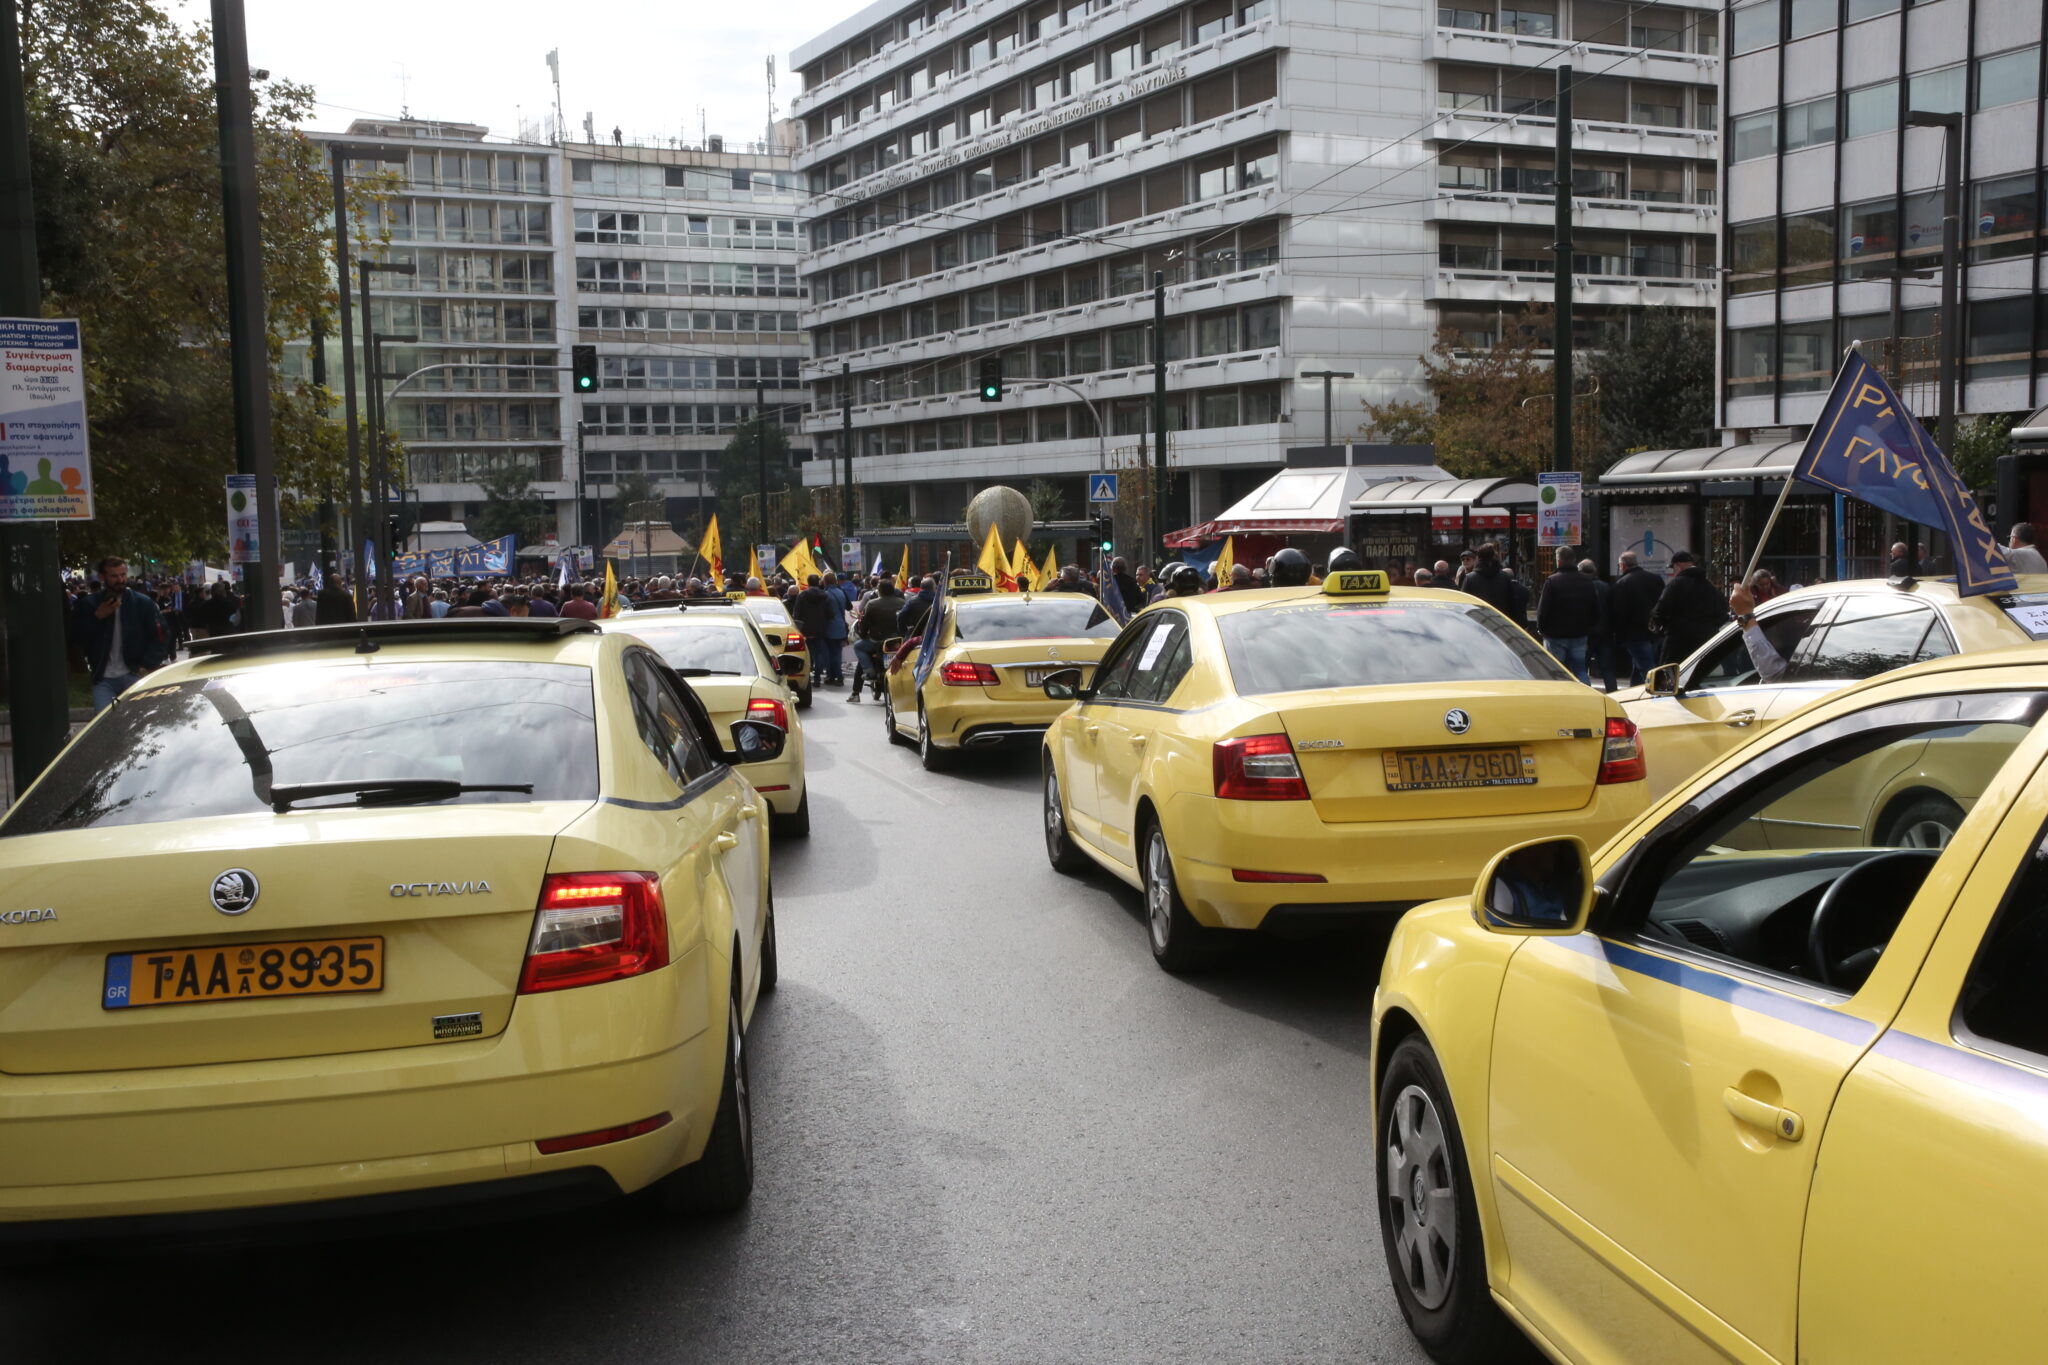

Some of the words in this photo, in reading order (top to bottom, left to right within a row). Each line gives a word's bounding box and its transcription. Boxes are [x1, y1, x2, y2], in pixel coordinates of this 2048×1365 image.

[922, 153, 960, 175] ΥΠΟΥΡΓΕΙΟ
[964, 133, 1011, 159] ΟΙΚΟΝΟΜΙΑΣ
[1129, 65, 1187, 97] ΝΑΥΤΙΛΙΑΣ
[17, 324, 59, 332] ΕΠΙΤΡΟΠΗ
[5, 351, 72, 361] Συγκέντρωση
[5, 362, 74, 373] διαμαρτυρίας
[28, 420, 80, 430] στοχοποίηση
[33, 432, 74, 441] αφανισμό
[9, 496, 35, 504] μέτρα
[20, 505, 76, 514] φοροδιαφυγή
[1366, 545, 1389, 558] ΠΑΡΩ
[1392, 544, 1415, 557] ΔΩΡΟ
[958, 579, 982, 587] TAXI
[1341, 575, 1379, 589] TAXI
[389, 880, 493, 897] OCTAVIA
[108, 986, 127, 999] GR
